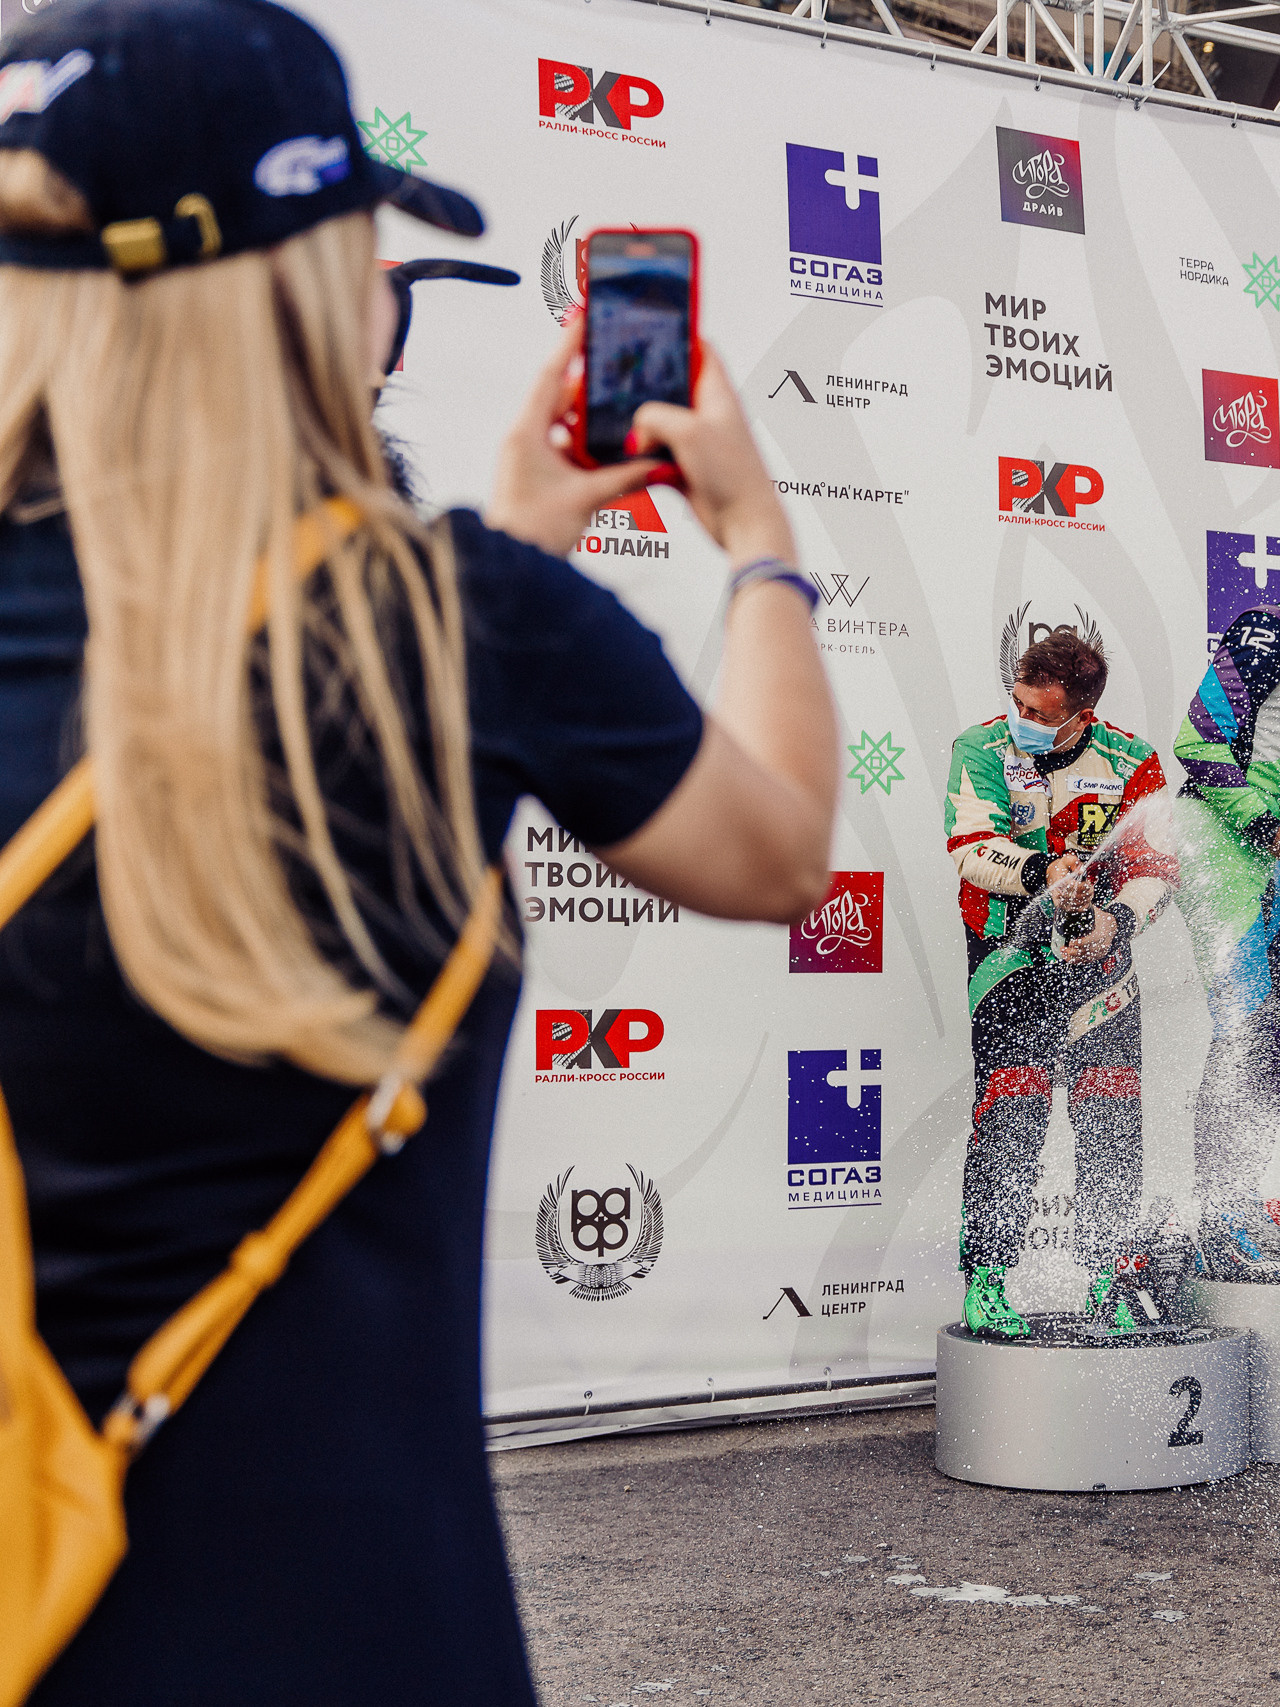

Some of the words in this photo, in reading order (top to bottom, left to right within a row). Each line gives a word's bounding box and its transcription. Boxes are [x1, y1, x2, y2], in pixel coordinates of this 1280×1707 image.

[538, 119, 619, 141] РАЛЛИ-КРОСС
[621, 133, 667, 149] РОССИИ
[1022, 201, 1064, 217] ДРАЙВ
[789, 256, 884, 286] СОГАЗ
[1179, 257, 1215, 271] ТЕРРА
[1180, 270, 1229, 287] НОРДИКА
[790, 278, 884, 301] МЕДИЦИНА
[985, 292, 1046, 321] МИР
[984, 322, 1080, 358] ТВОИХ
[985, 353, 1113, 392] ЭМОЦИЙ
[826, 375, 909, 397] ЛЕНИНГРАД
[826, 394, 870, 409] ЦЕНТР
[998, 514, 1065, 529] РАЛЛИ-КРОСС
[1067, 521, 1106, 532] РОССИИ
[575, 534, 670, 559] ТОЛАЙН
[827, 618, 910, 637] ВИНТЕРА
[527, 826, 592, 853] МИ
[535, 1073, 616, 1083] РАЛЛИ-КРОСС
[619, 1072, 665, 1082] РОССИИ
[787, 1166, 882, 1187] СОГАЗ
[788, 1188, 882, 1203] МЕДИЦИНА
[822, 1279, 905, 1297] ЛЕНИНГРАД
[822, 1301, 866, 1317] ЦЕНТР
[1168, 1375, 1203, 1447] 2
